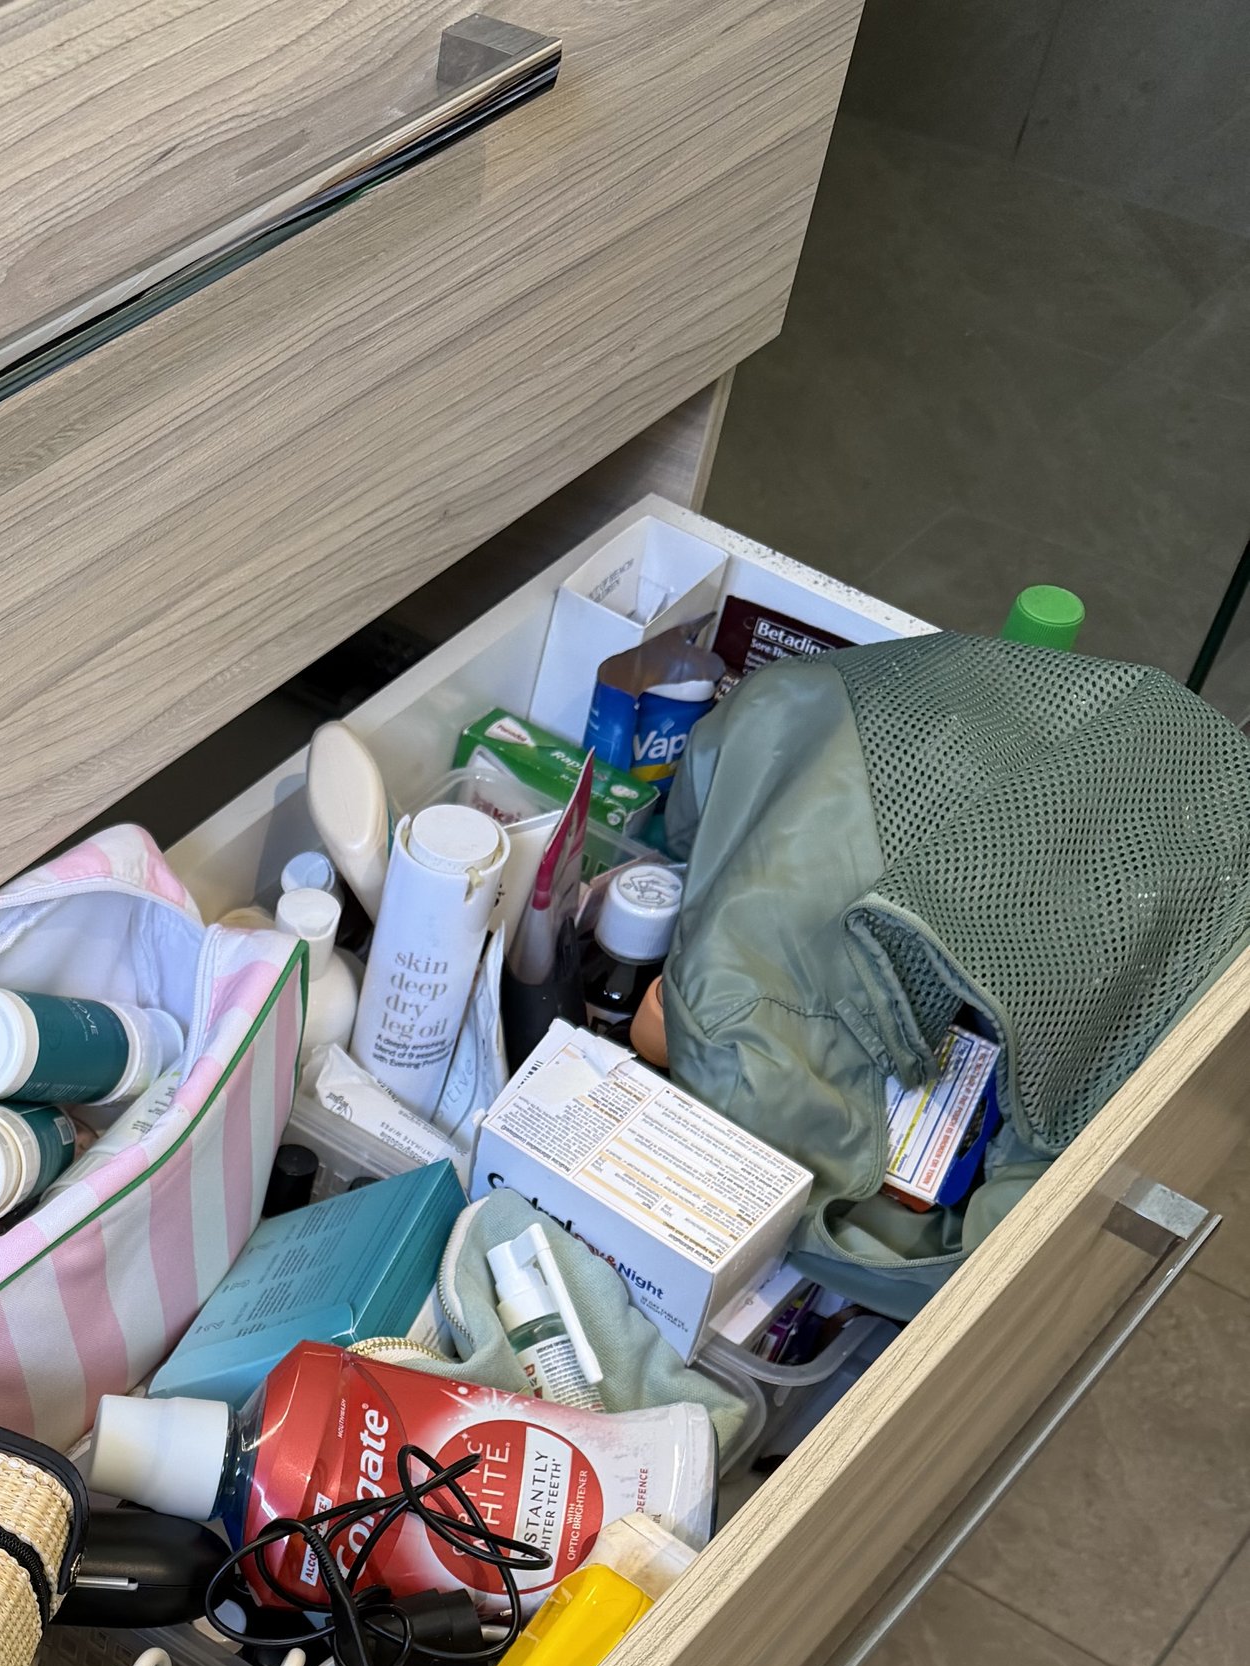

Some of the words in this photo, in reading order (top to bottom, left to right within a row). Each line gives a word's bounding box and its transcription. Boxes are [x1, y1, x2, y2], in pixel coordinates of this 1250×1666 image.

[756, 621, 826, 660] Betadin
[395, 951, 449, 974] skin
[390, 971, 448, 1001] deep
[385, 994, 428, 1021] dry
[381, 1012, 416, 1041] leg
[419, 1018, 448, 1040] oil
[375, 1043, 395, 1057] blend
[397, 1049, 407, 1059] of
[383, 1036, 411, 1052] deeply
[412, 1039, 446, 1052] enriching
[373, 1053, 390, 1067] with
[390, 1056, 419, 1070] Evening
[934, 1134, 950, 1158] BROKEN
[930, 1157, 939, 1168] OR
[922, 1168, 935, 1186] TORN
[337, 1399, 346, 1439] MOUTHWASH
[573, 1470, 589, 1531] BRIGHTENER
[636, 1467, 649, 1514] DEFENCE
[566, 1502, 576, 1525] WITH
[567, 1530, 581, 1561] OPTIC
